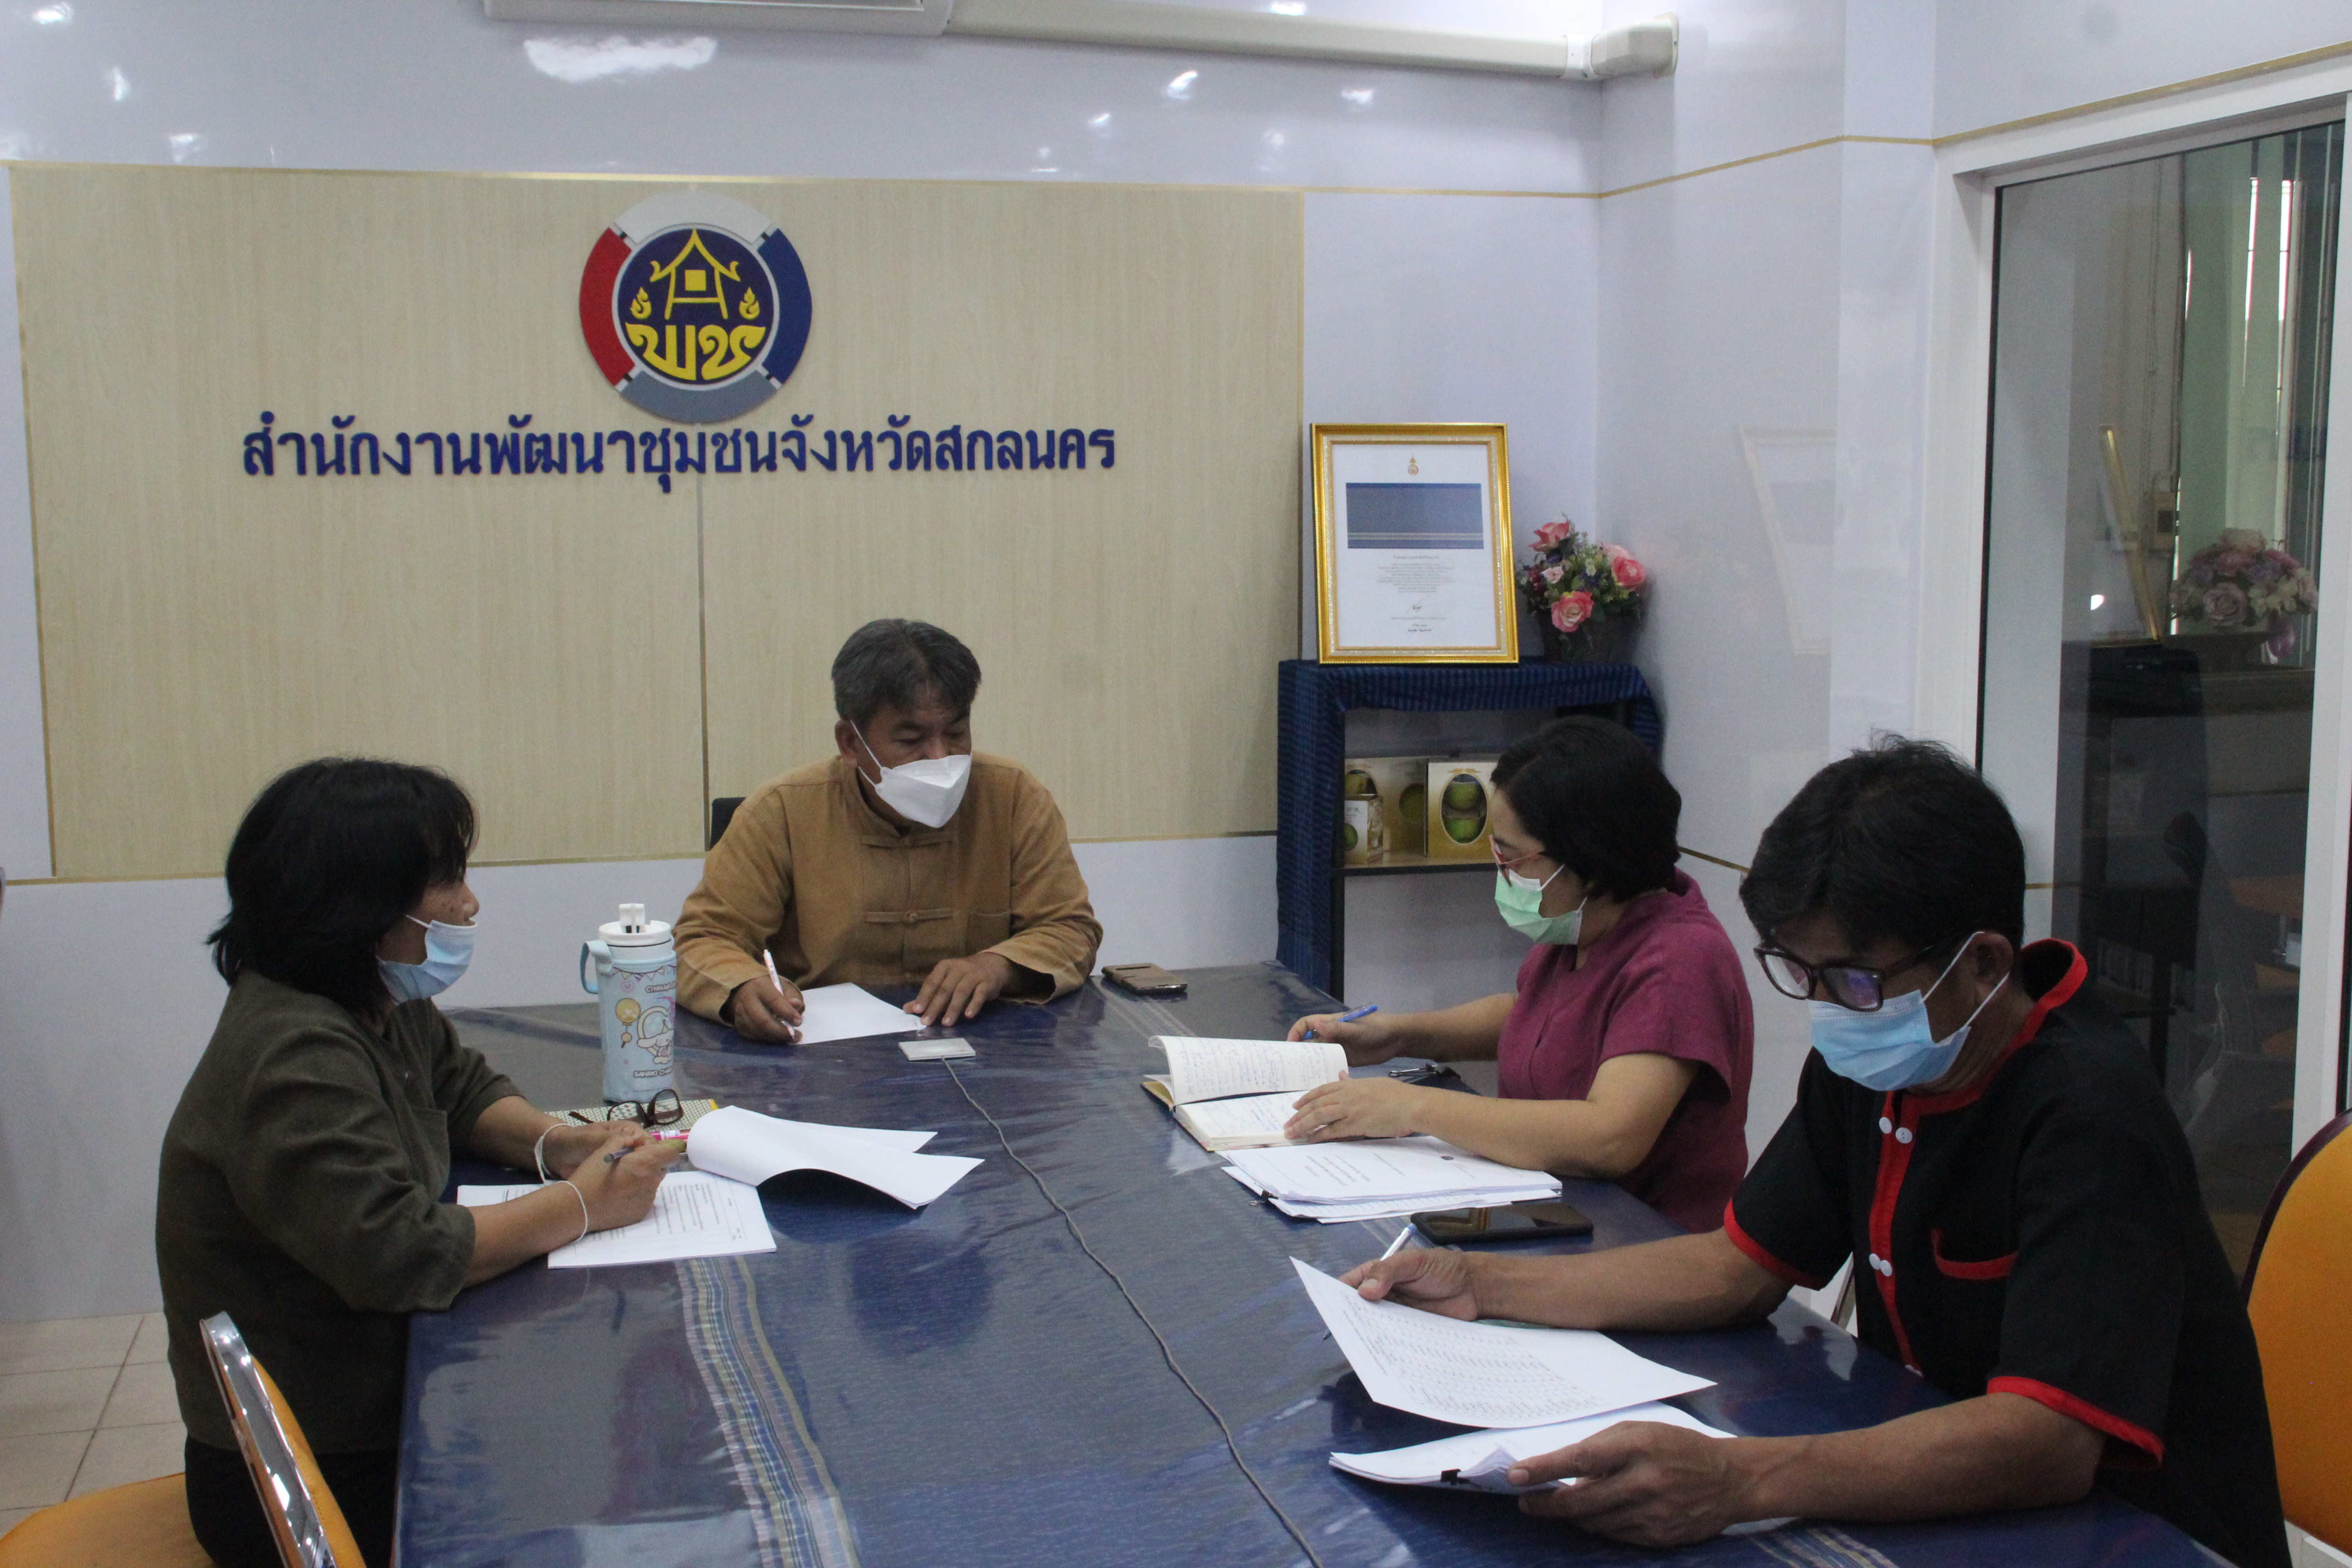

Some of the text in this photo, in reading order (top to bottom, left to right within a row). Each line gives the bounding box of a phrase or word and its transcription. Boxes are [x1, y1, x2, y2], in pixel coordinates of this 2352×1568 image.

[243, 411, 1115, 493] สำนักงานพัฒนาชุมชนจังหวัดสกลนคร
